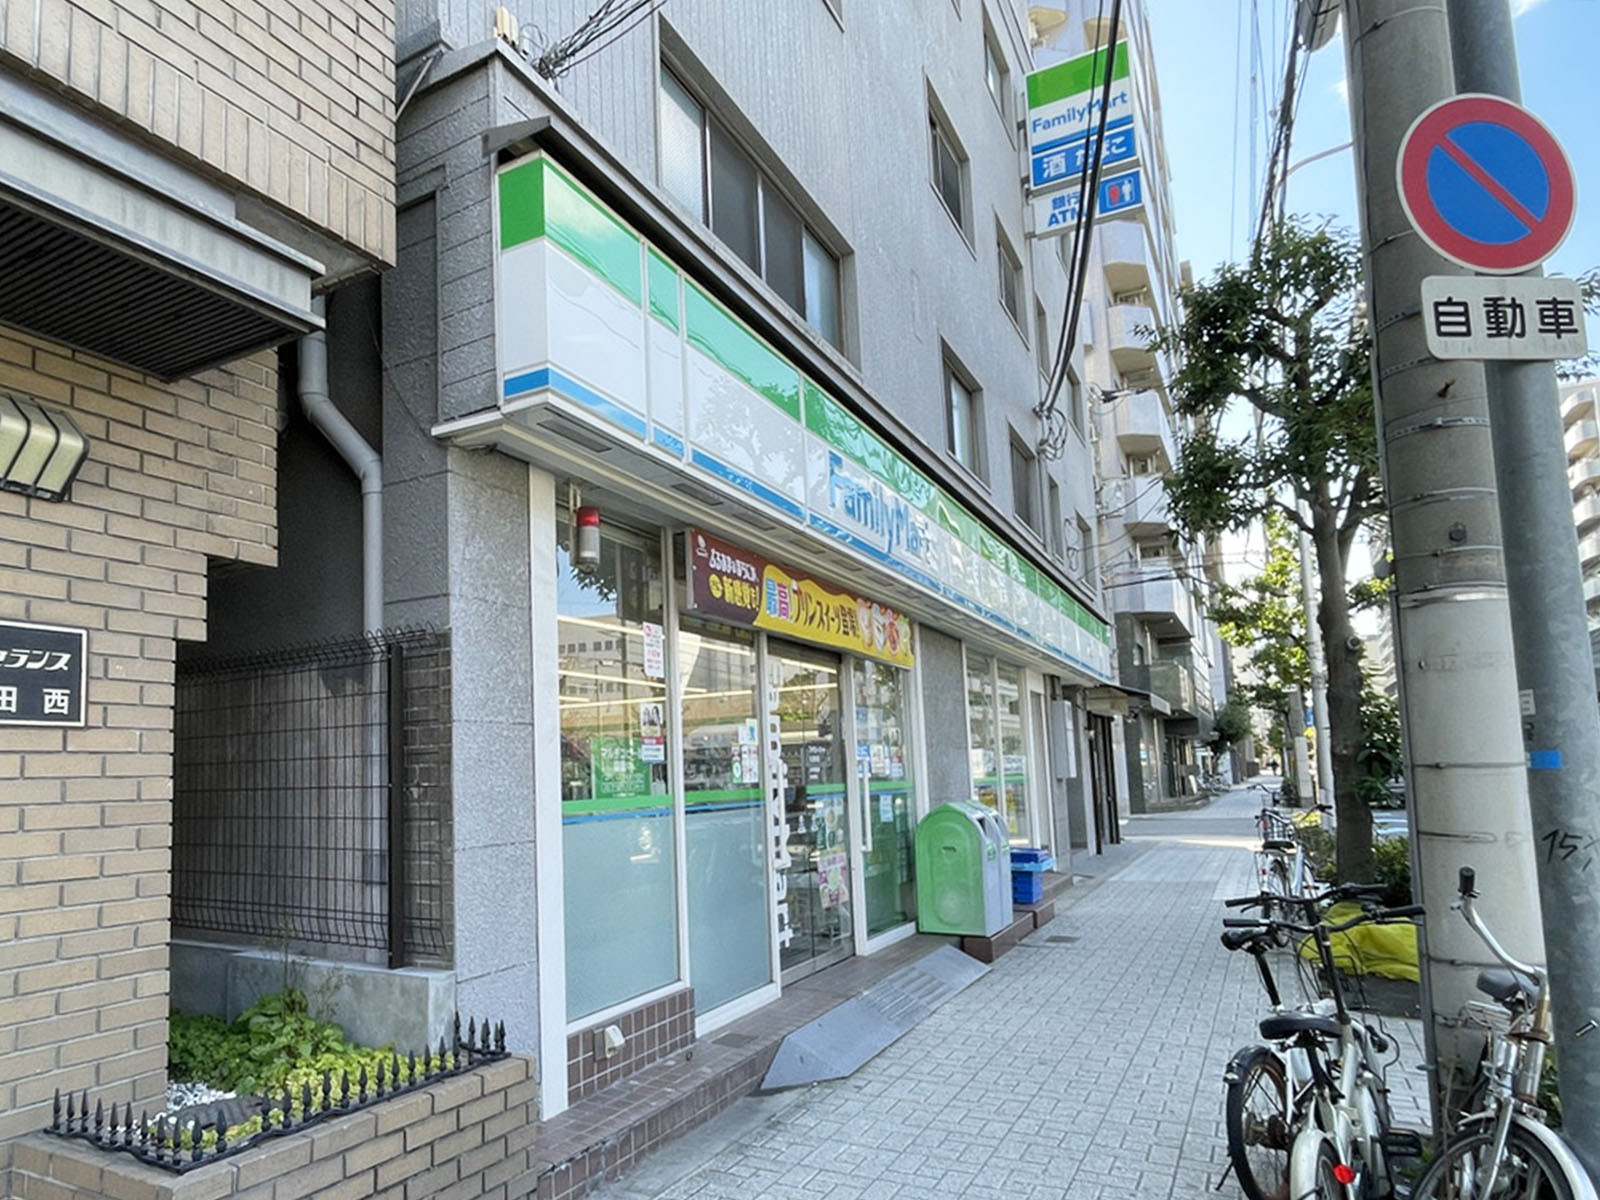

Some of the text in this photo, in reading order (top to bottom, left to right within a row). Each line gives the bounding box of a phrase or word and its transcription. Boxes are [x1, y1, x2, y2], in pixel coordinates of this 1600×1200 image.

[1032, 91, 1128, 133] FamilyMrt
[1433, 296, 1579, 340] 自動車
[828, 450, 931, 564] FamilyMa
